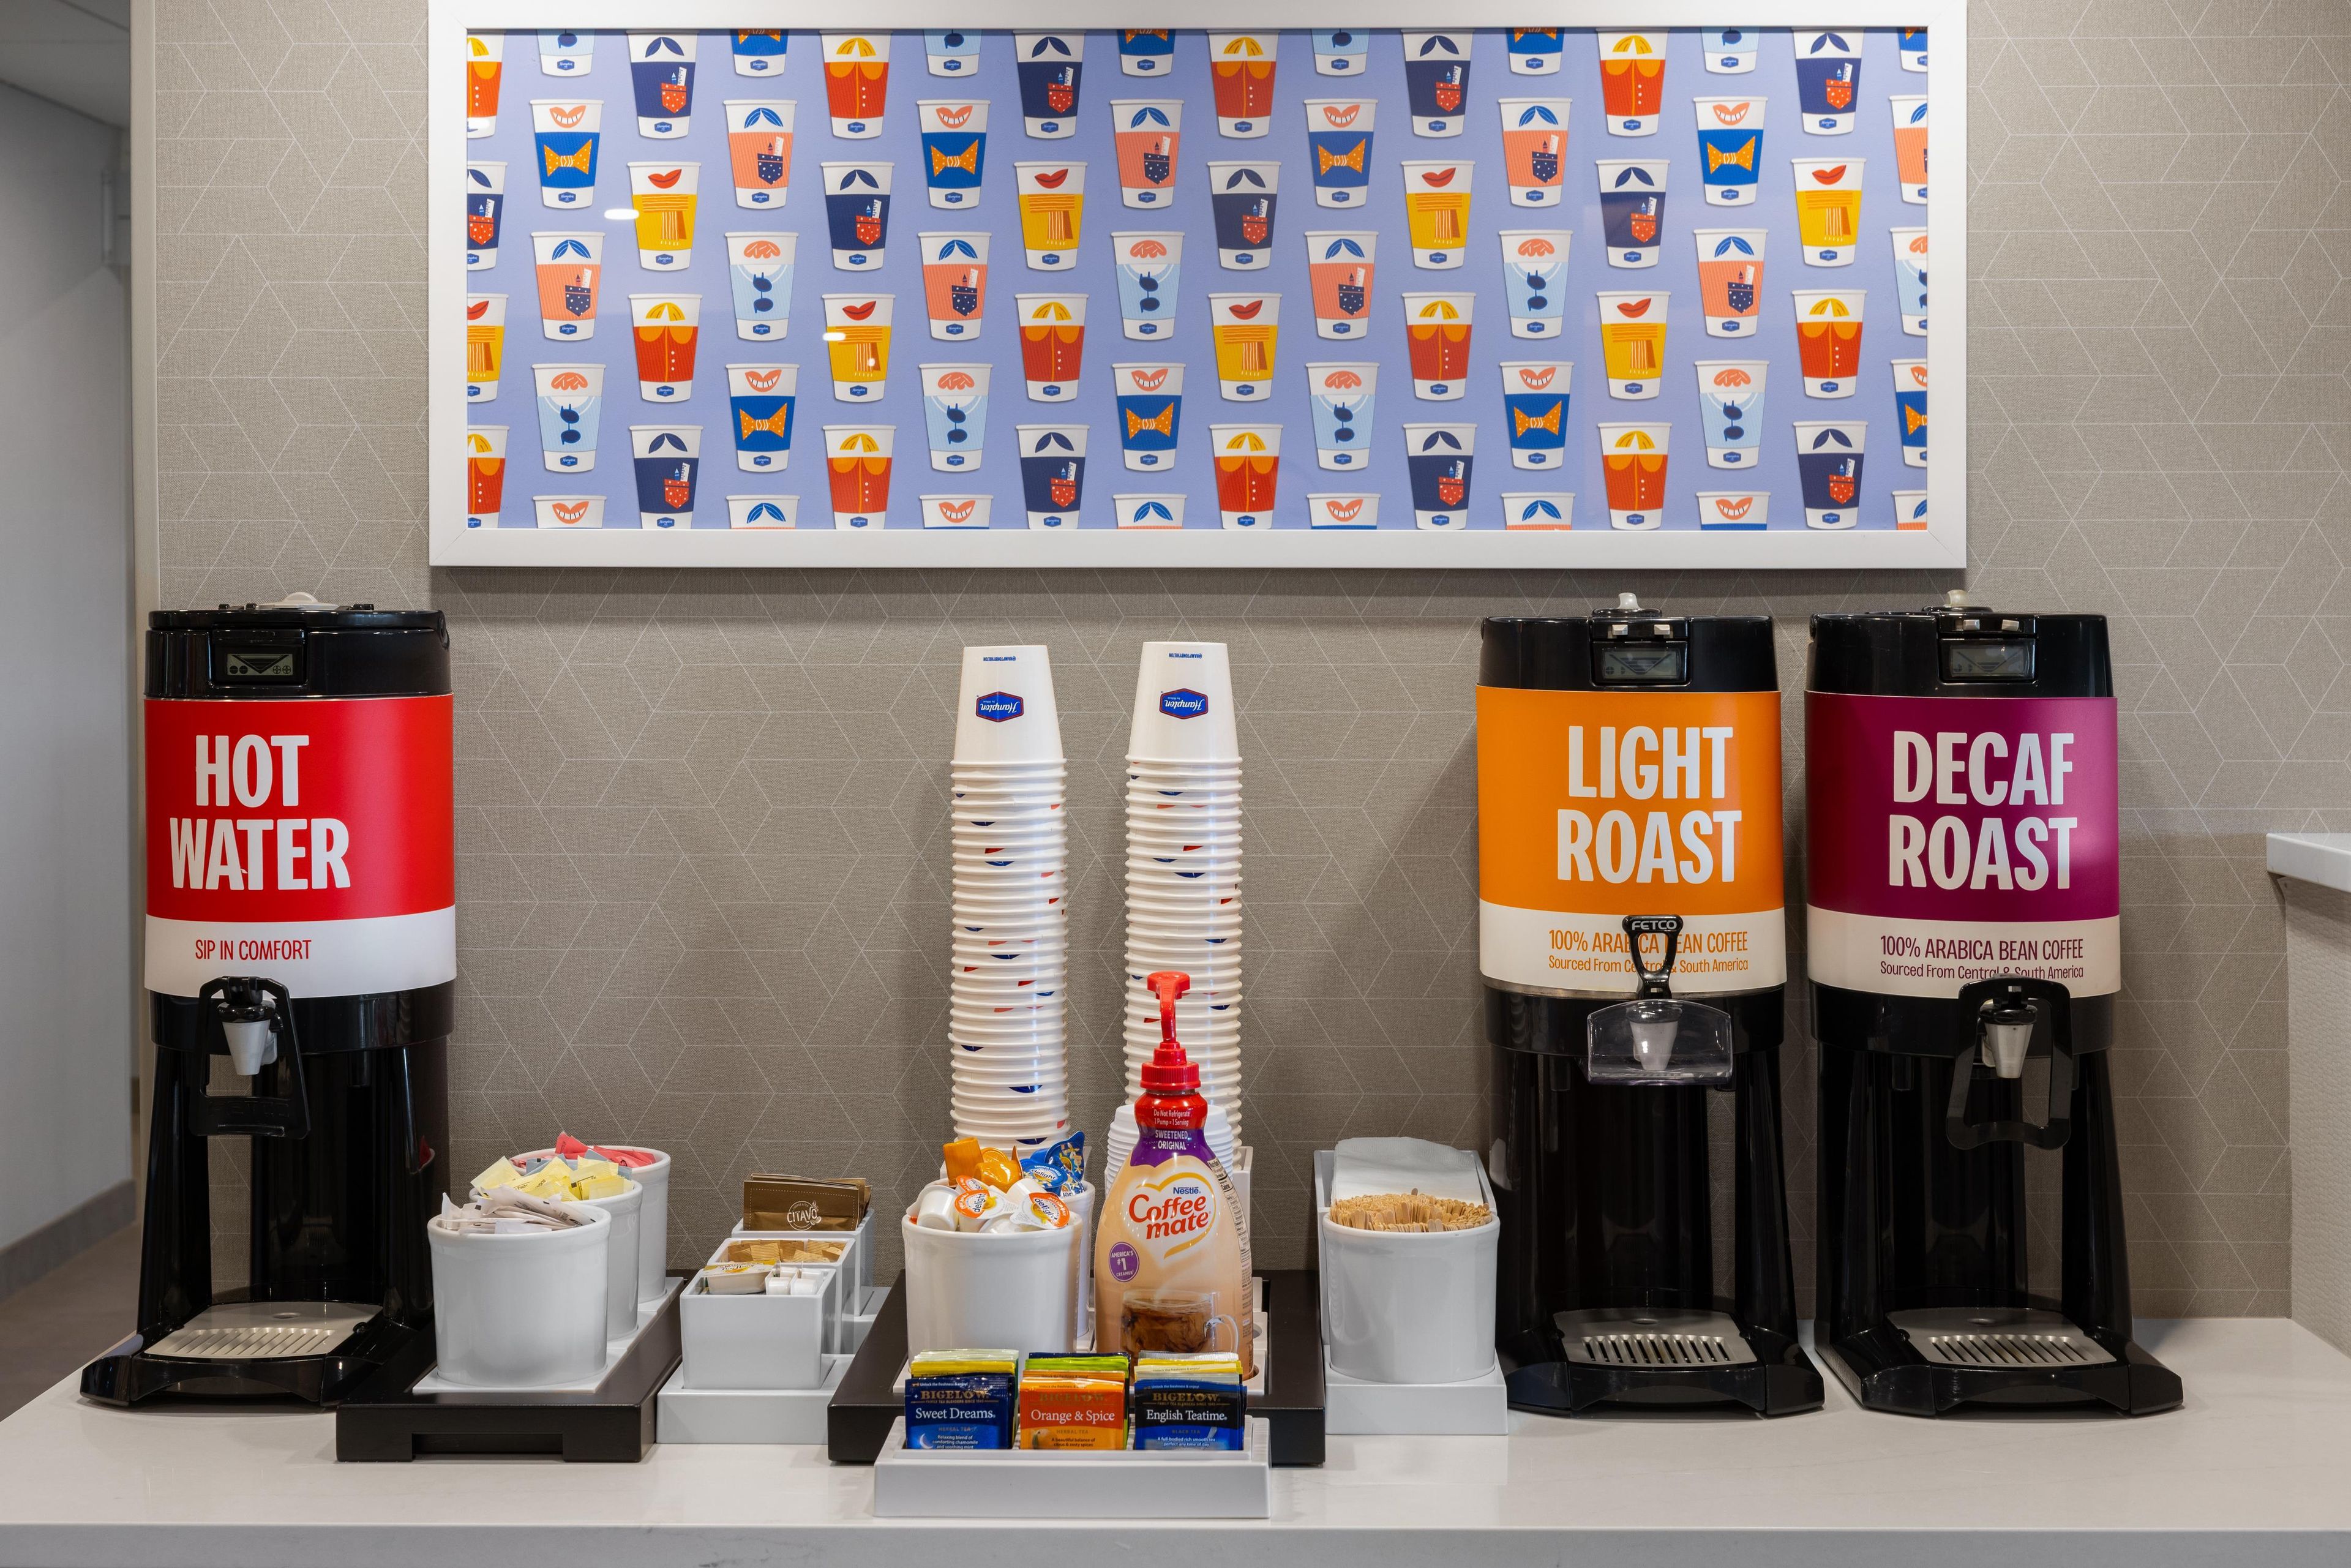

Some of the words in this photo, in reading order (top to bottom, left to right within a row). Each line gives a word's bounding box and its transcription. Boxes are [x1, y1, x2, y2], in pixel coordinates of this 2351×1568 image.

[980, 701, 1020, 714] Hampton
[1164, 698, 1205, 711] Hampton
[195, 735, 309, 808] HOT
[1569, 726, 1733, 800] LIGHT
[1893, 730, 2075, 806] DECAF
[170, 817, 351, 890] WATER
[1557, 809, 1742, 884] ROAST
[1889, 814, 2078, 891] ROAST
[1632, 920, 1678, 930] FETCO
[195, 939, 216, 959] SIP
[220, 940, 233, 959] IN
[239, 939, 312, 960] COMFORT
[1549, 929, 1588, 952] 100%
[1707, 931, 1748, 952] COFFEE
[1880, 936, 1921, 957] 100%
[1925, 939, 1994, 961] ARABICA
[1999, 940, 2038, 961] BEAN
[2042, 939, 2083, 961] COFFEE
[1549, 955, 1591, 971] Sourced
[1594, 958, 1621, 972] From
[1680, 959, 1711, 973] South
[1712, 958, 1748, 972] America
[1880, 961, 1924, 977] Sourced
[1926, 964, 1955, 978] From
[2047, 964, 2083, 979] America
[1168, 1110, 1190, 1119] Refrigerate
[1155, 1130, 1188, 1139] SWEETENED
[1158, 1140, 1187, 1150] ORIGINAL
[1031, 1169, 1056, 1180] delight
[972, 1193, 986, 1213] delight
[1035, 1198, 1058, 1220] delight
[1129, 1194, 1206, 1223] Coffee
[787, 1206, 817, 1223] CITAVO
[1146, 1212, 1209, 1239] mate
[920, 1390, 988, 1400] BIGELOW
[1040, 1393, 1105, 1401] BIGELOW
[1152, 1392, 1218, 1401] BIGELOW
[915, 1407, 947, 1419] Sweet
[950, 1408, 993, 1419] Dreams
[1031, 1409, 1072, 1424] Orange
[1074, 1411, 1084, 1421] &
[1086, 1409, 1115, 1424] Spice
[1146, 1409, 1183, 1423] English
